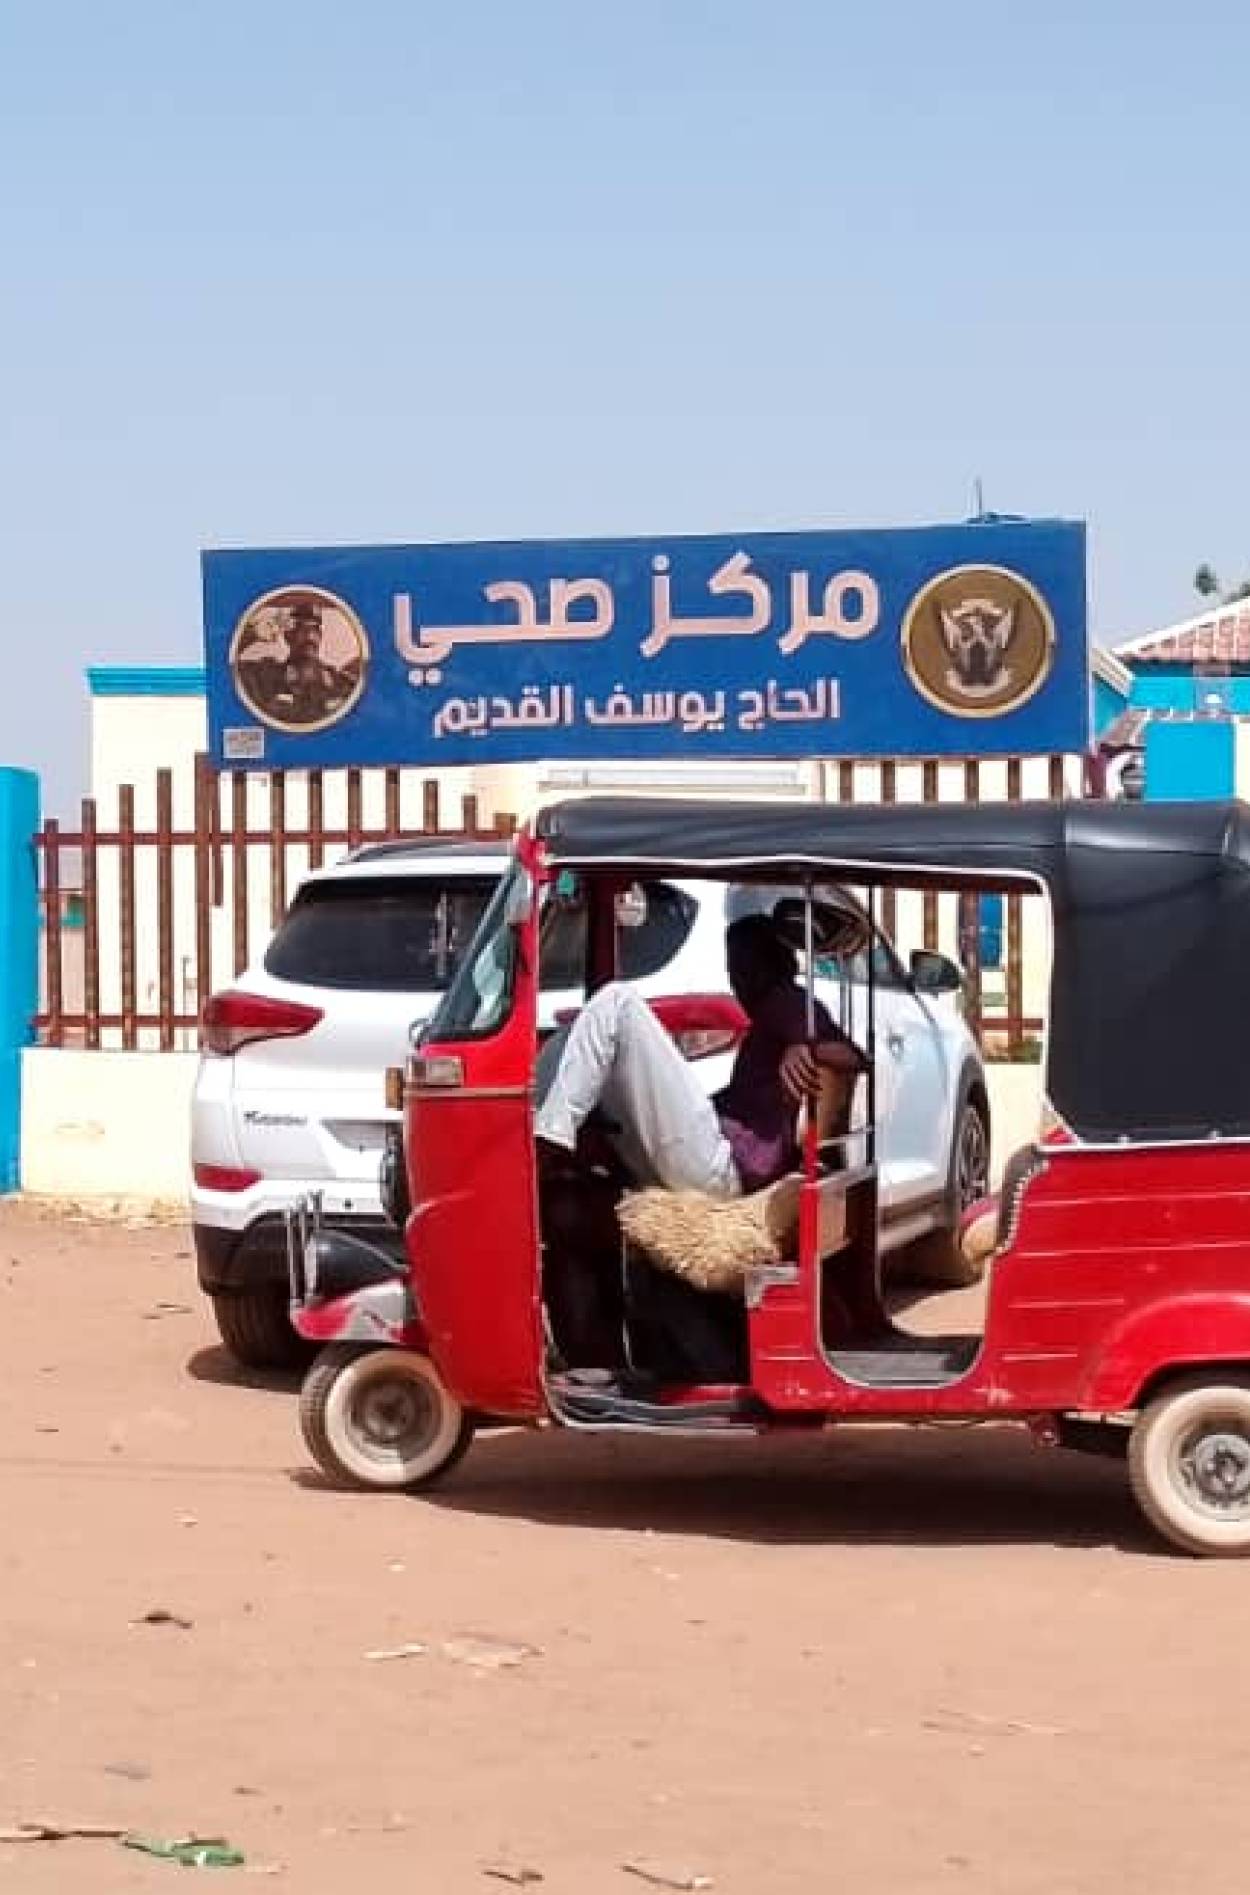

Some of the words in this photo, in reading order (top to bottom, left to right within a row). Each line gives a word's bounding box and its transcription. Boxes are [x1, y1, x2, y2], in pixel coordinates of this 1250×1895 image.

[640, 550, 879, 658] مركز
[393, 577, 616, 686] صحي
[433, 684, 574, 738] القديم
[584, 684, 725, 733] يوسف
[738, 678, 841, 731] الحاج
